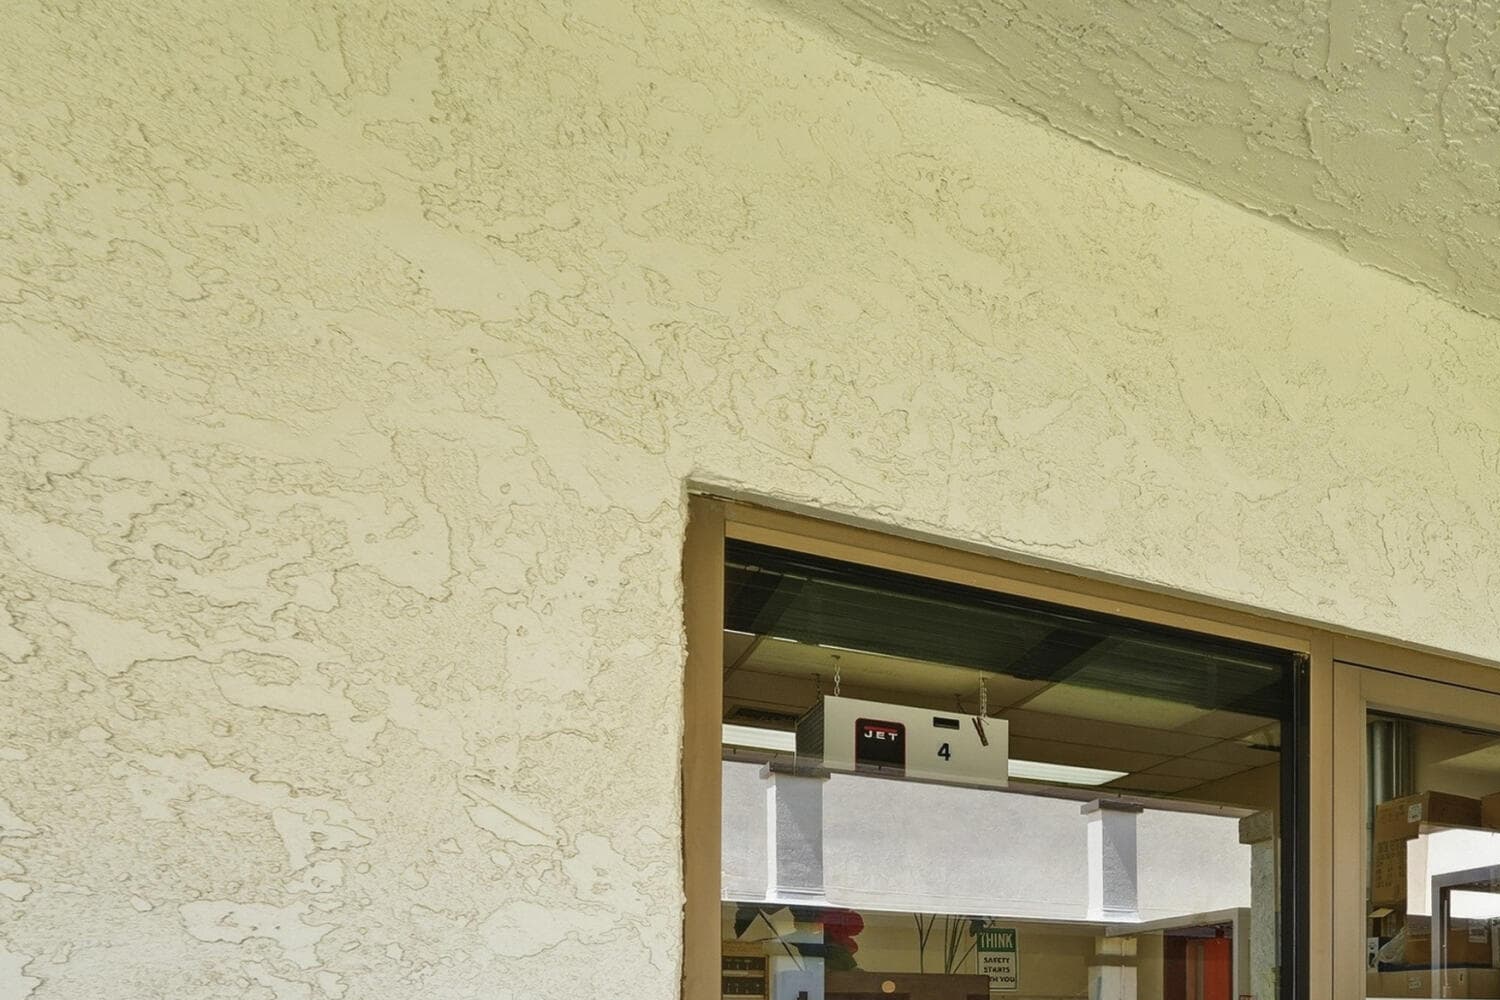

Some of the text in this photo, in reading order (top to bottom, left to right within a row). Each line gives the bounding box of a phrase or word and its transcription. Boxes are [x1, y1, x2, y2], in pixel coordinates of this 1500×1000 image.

[864, 730, 898, 741] JET
[937, 743, 951, 761] 4
[979, 932, 1013, 948] THINK
